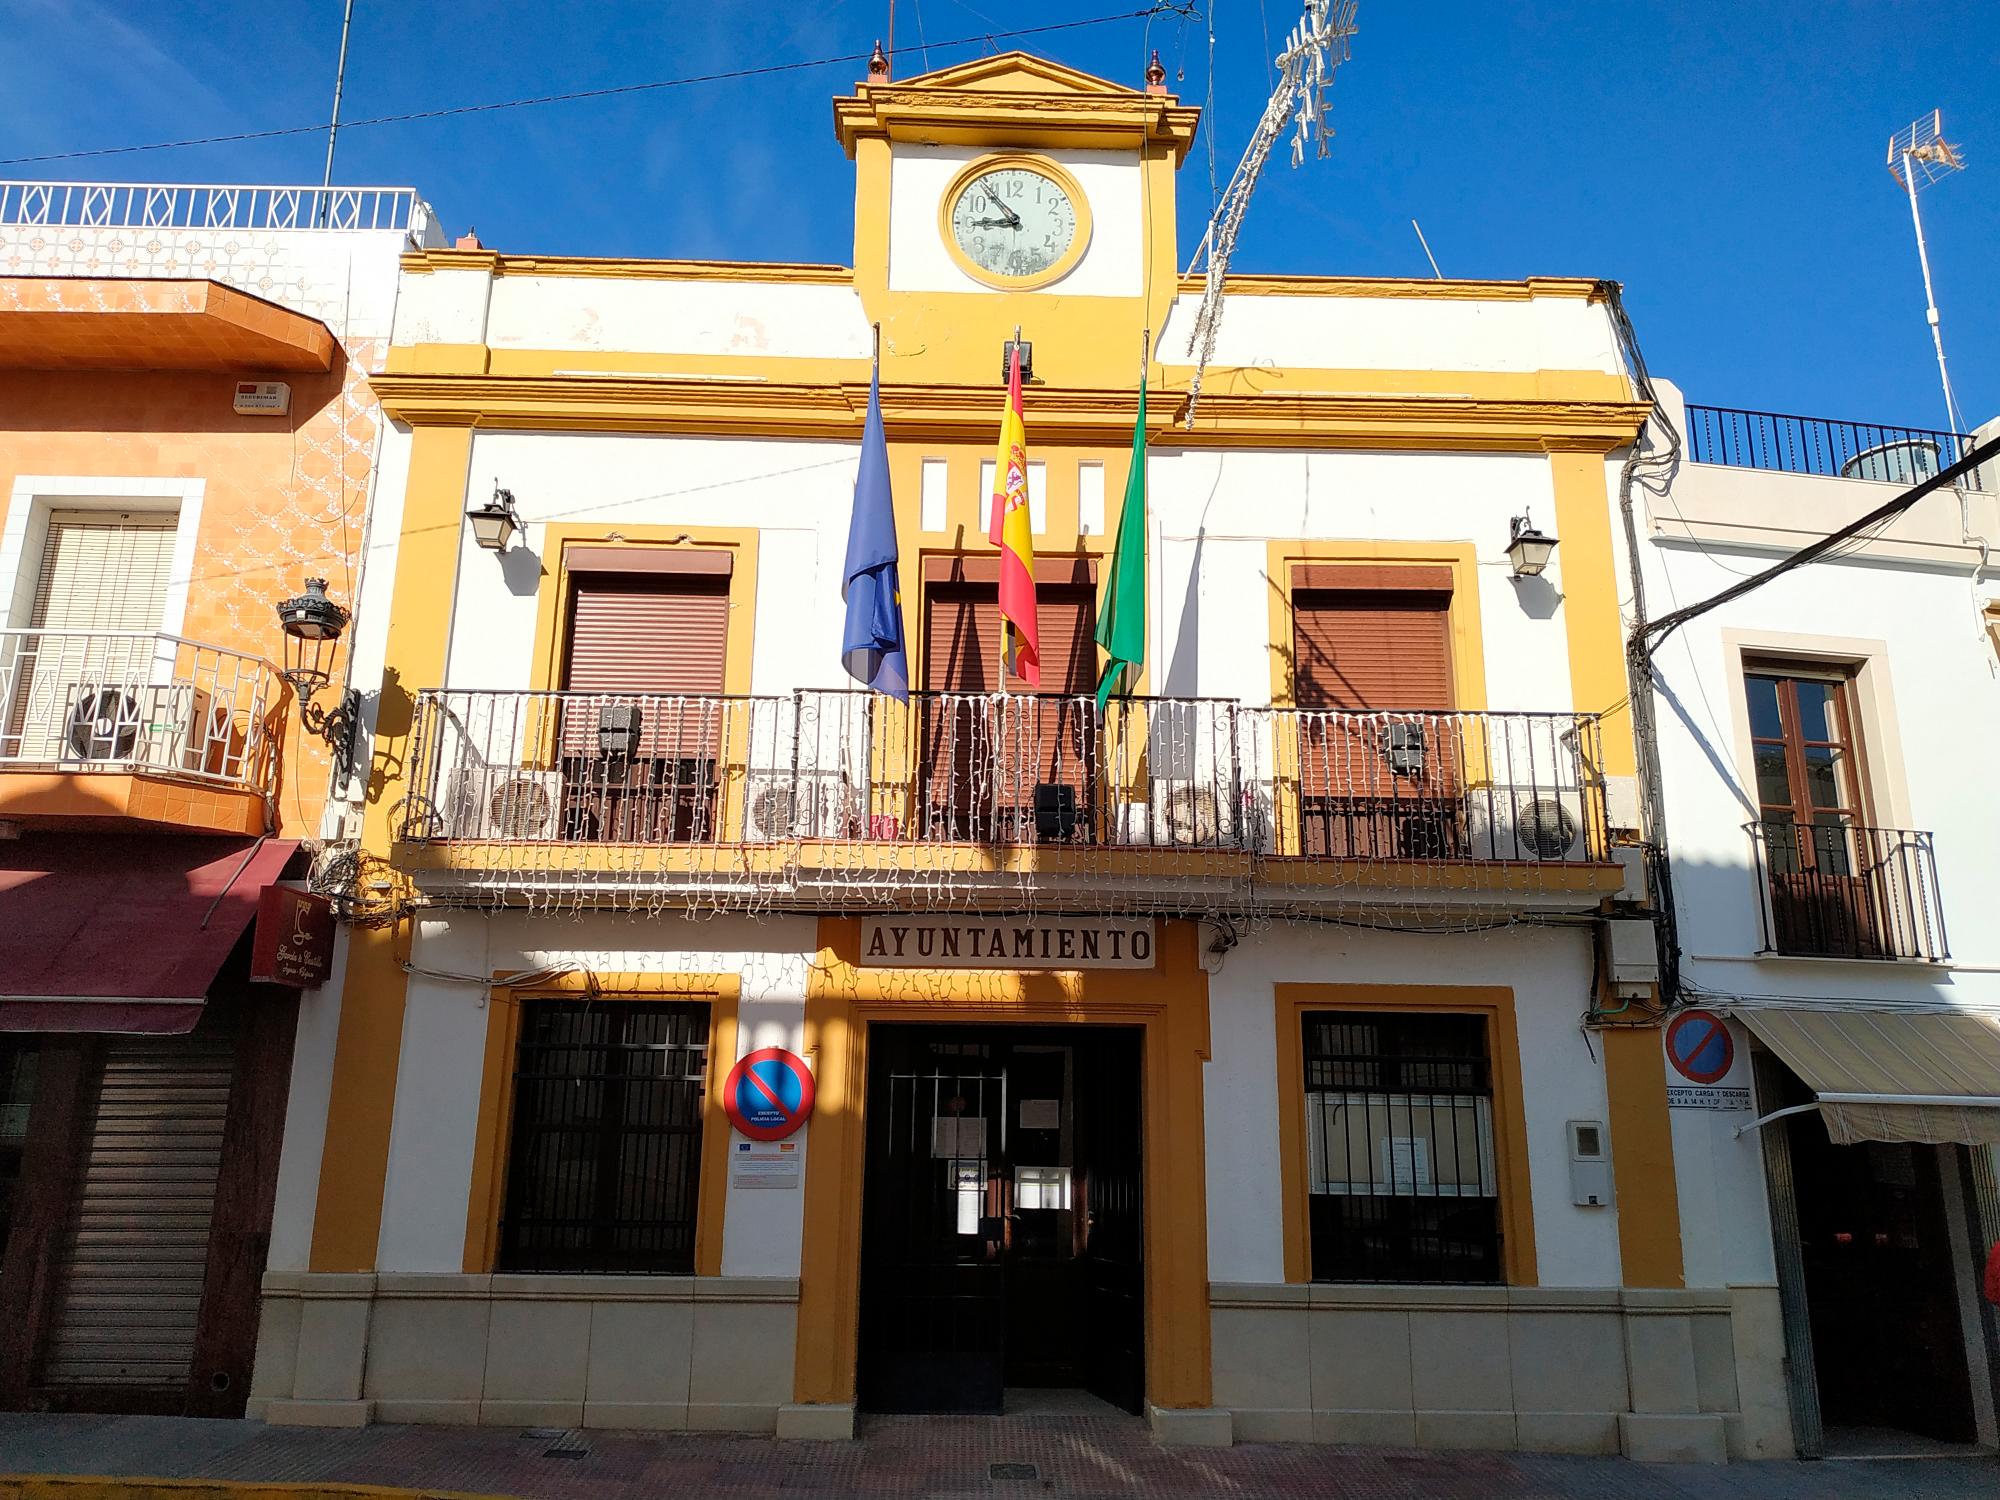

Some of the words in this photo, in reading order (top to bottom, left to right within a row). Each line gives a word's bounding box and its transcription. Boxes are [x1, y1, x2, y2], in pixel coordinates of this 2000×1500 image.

[1005, 180, 1024, 198] 12
[1035, 186, 1042, 204] 1
[968, 194, 986, 213] 10
[1048, 197, 1059, 216] 2
[965, 216, 976, 234] 9
[1052, 218, 1064, 236] 3
[972, 236, 985, 254] 8
[1043, 235, 1055, 252] 4
[990, 244, 1005, 265] 7
[1008, 250, 1023, 270] 6
[1030, 247, 1042, 264] 5
[866, 926, 1151, 960] AYUNTAMIENTO
[1695, 1089, 1714, 1097] CARGA
[1722, 1090, 1750, 1098] DESCARGA
